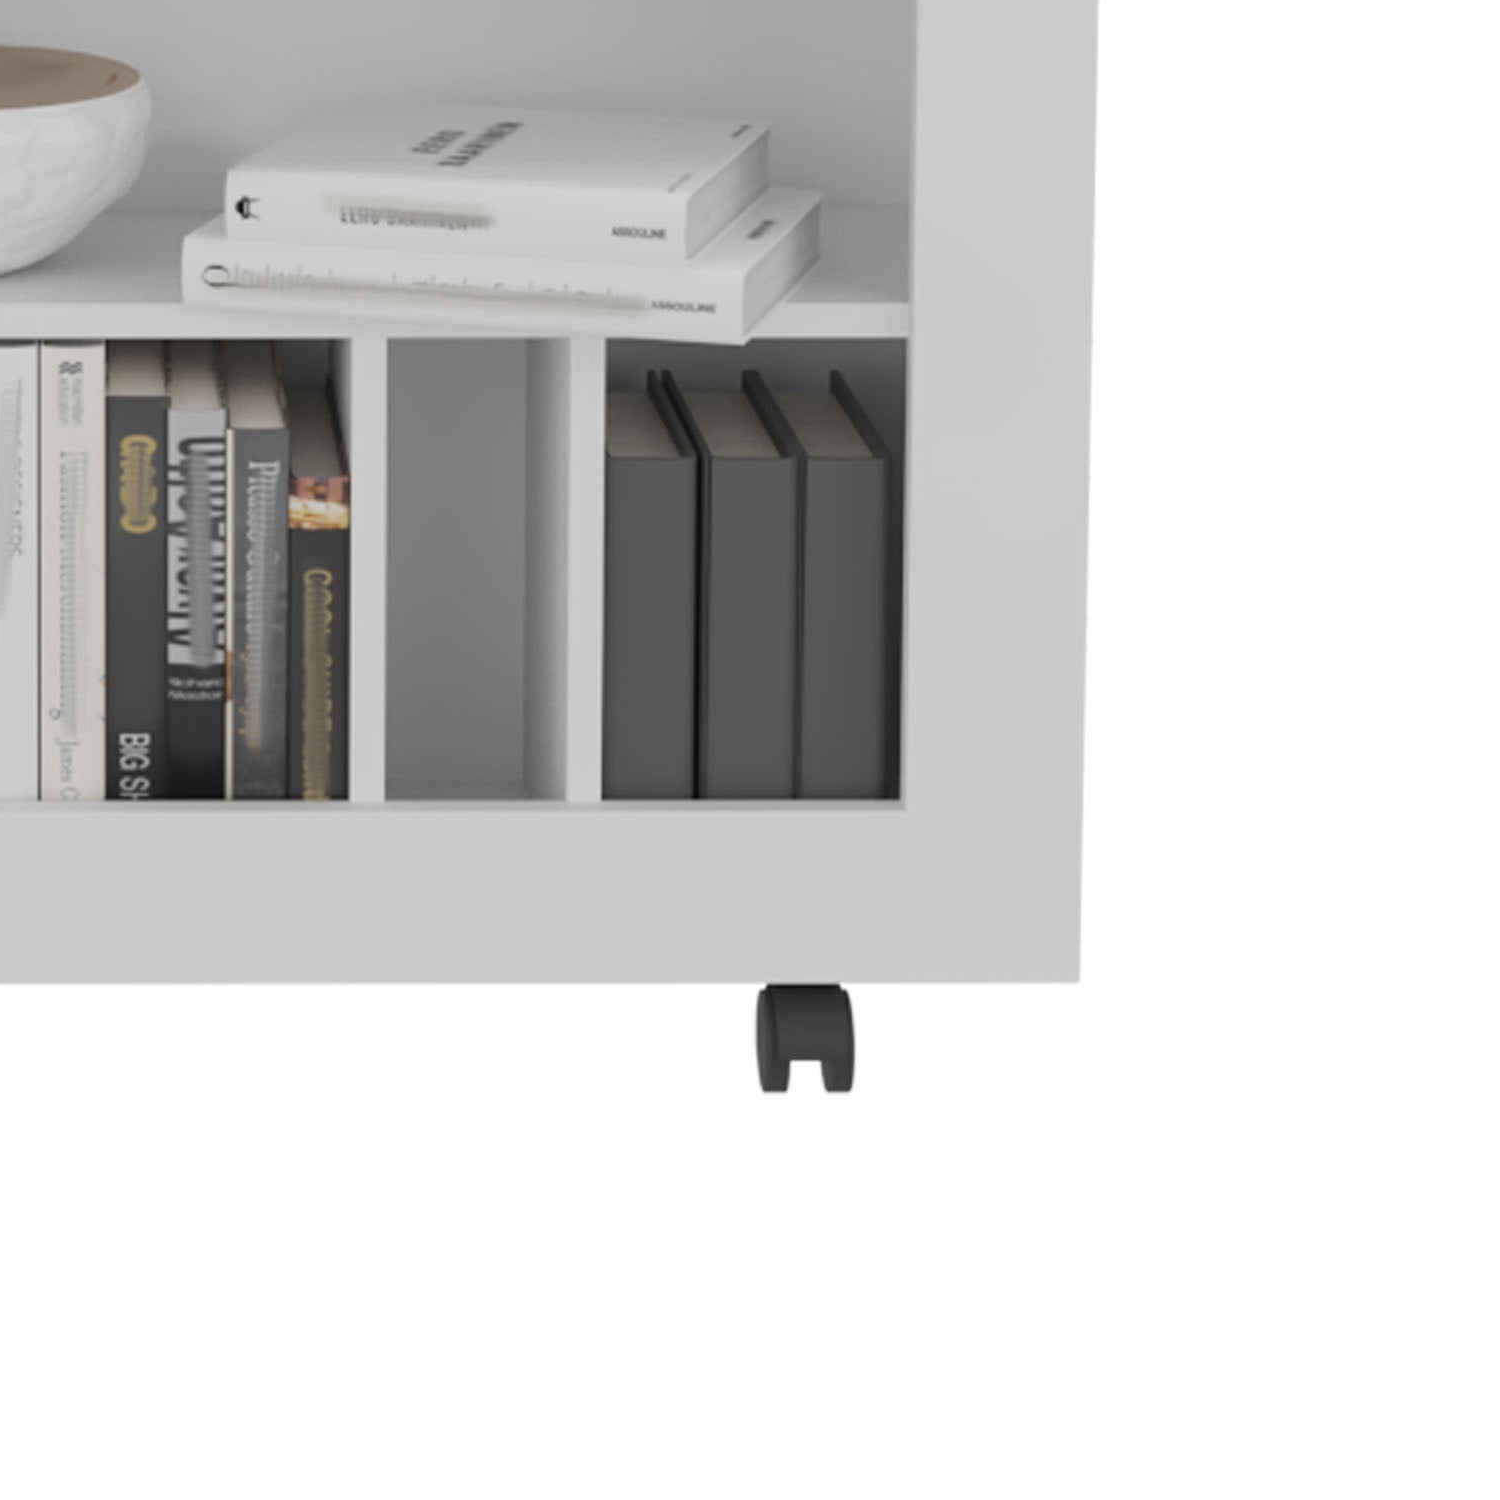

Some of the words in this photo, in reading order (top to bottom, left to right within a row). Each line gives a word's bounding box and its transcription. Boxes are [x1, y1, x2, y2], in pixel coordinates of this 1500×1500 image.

[611, 225, 667, 240] ASSOULINE
[651, 299, 716, 314] ASSOULINE
[52, 737, 80, 785] James
[118, 732, 152, 771] BIG
